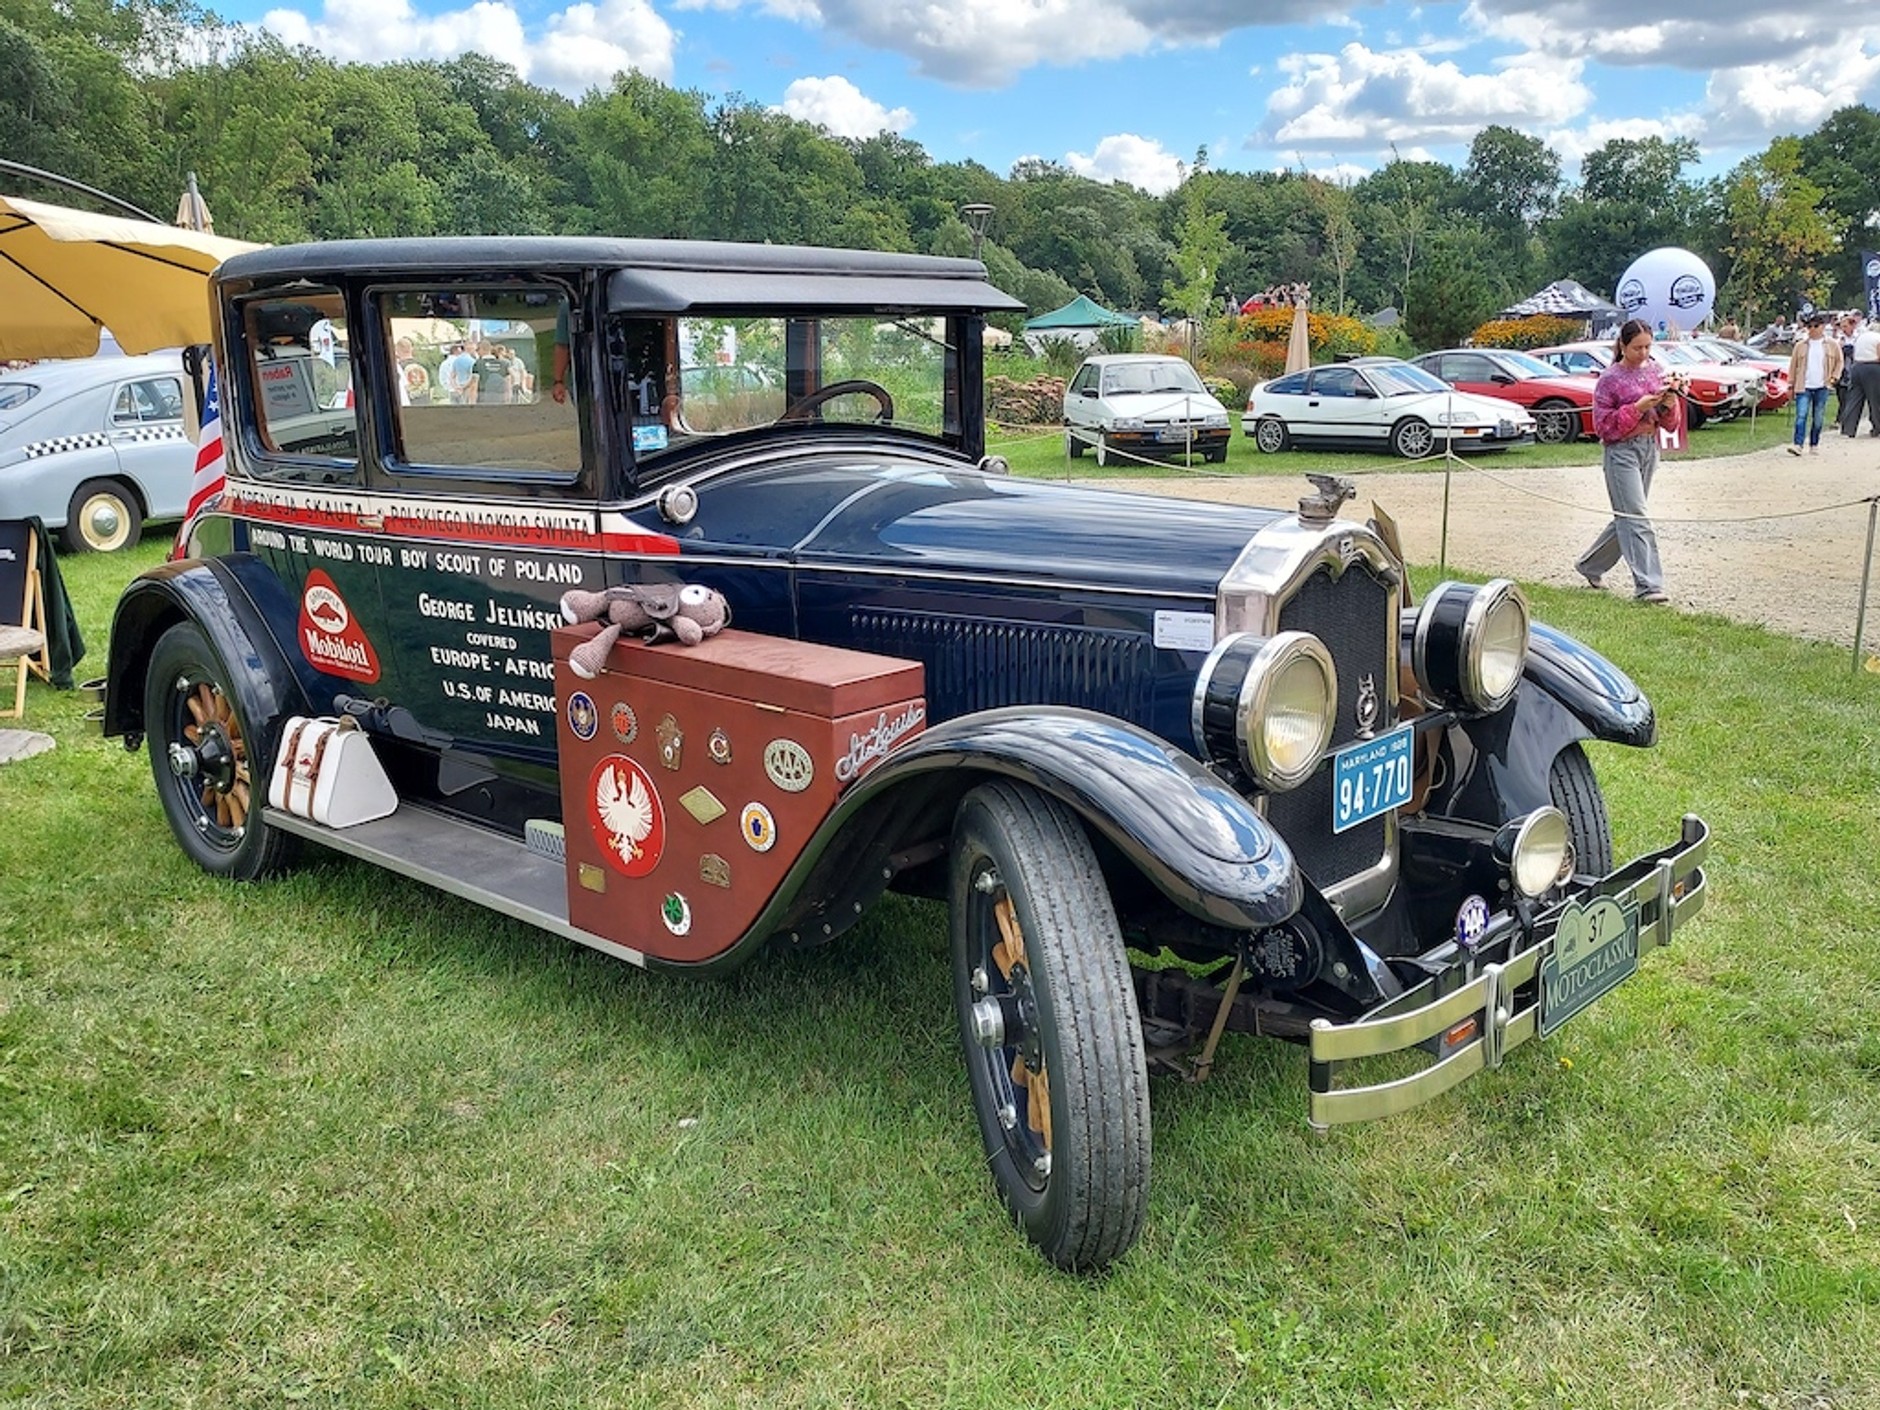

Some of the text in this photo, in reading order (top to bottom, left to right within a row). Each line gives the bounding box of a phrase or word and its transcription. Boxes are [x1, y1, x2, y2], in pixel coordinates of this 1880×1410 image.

[391, 505, 462, 533] POLSKIEGO
[535, 511, 592, 542] ŚWIATA
[252, 527, 583, 584] AROUND THE WORLD TOUR BOY SCOUT OF POLAND
[418, 592, 476, 622] GEORGE
[304, 628, 369, 667] Mobiloil
[466, 632, 518, 651] COVERED
[430, 646, 492, 672] EUROPE
[505, 657, 556, 681] AFRIC
[499, 689, 558, 713] AMERIC
[486, 712, 541, 736] JAPAN
[770, 749, 805, 780] AAA
[1341, 745, 1388, 773] MARYLAND
[1463, 907, 1485, 939] AAA
[1588, 907, 1606, 944] 37
[1545, 924, 1637, 1017] MOTOCLASSIC
